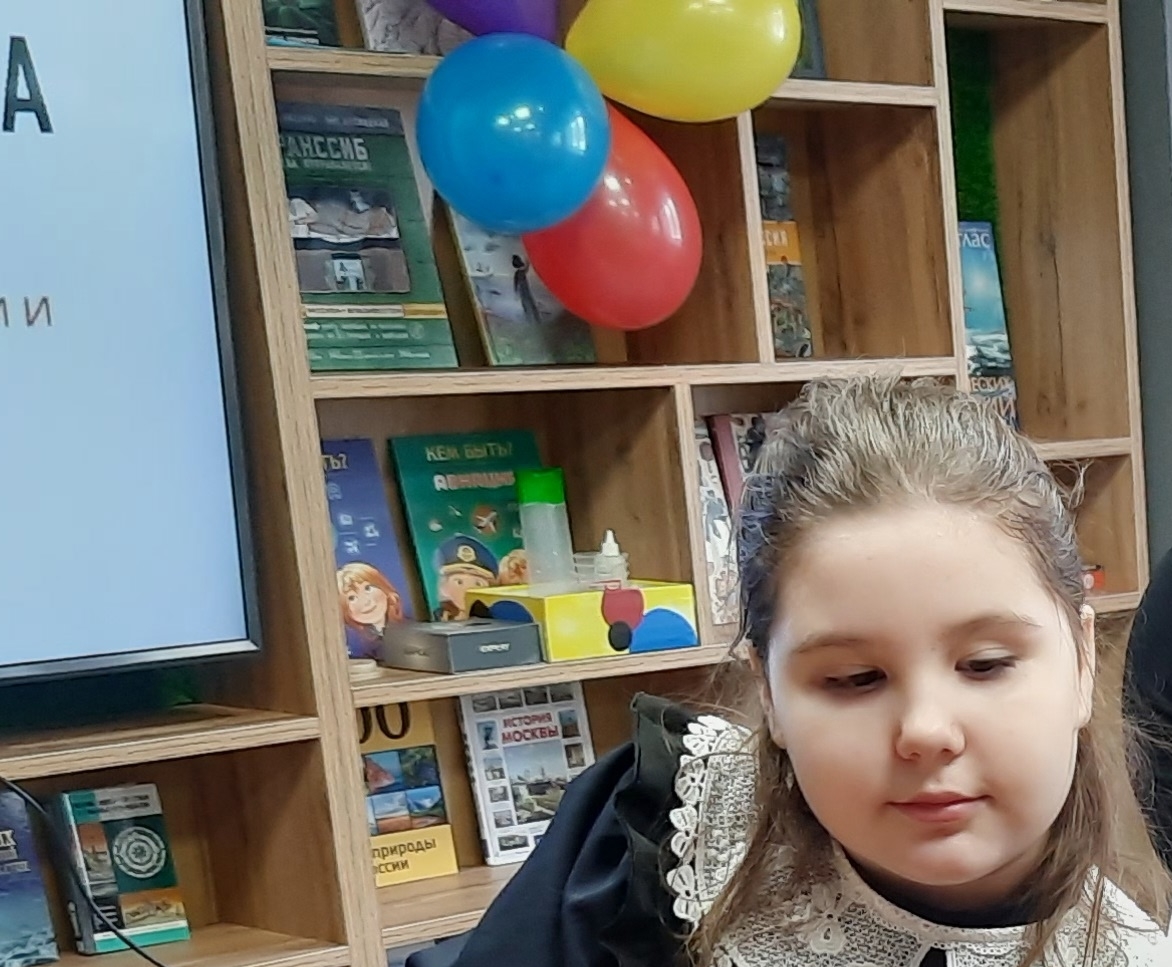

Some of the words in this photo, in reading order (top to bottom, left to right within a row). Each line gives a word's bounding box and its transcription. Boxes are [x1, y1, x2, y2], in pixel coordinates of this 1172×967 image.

[503, 712, 553, 728] ИСТОРИЯ
[502, 726, 559, 744] МОСКВЫ
[372, 838, 437, 860] природы
